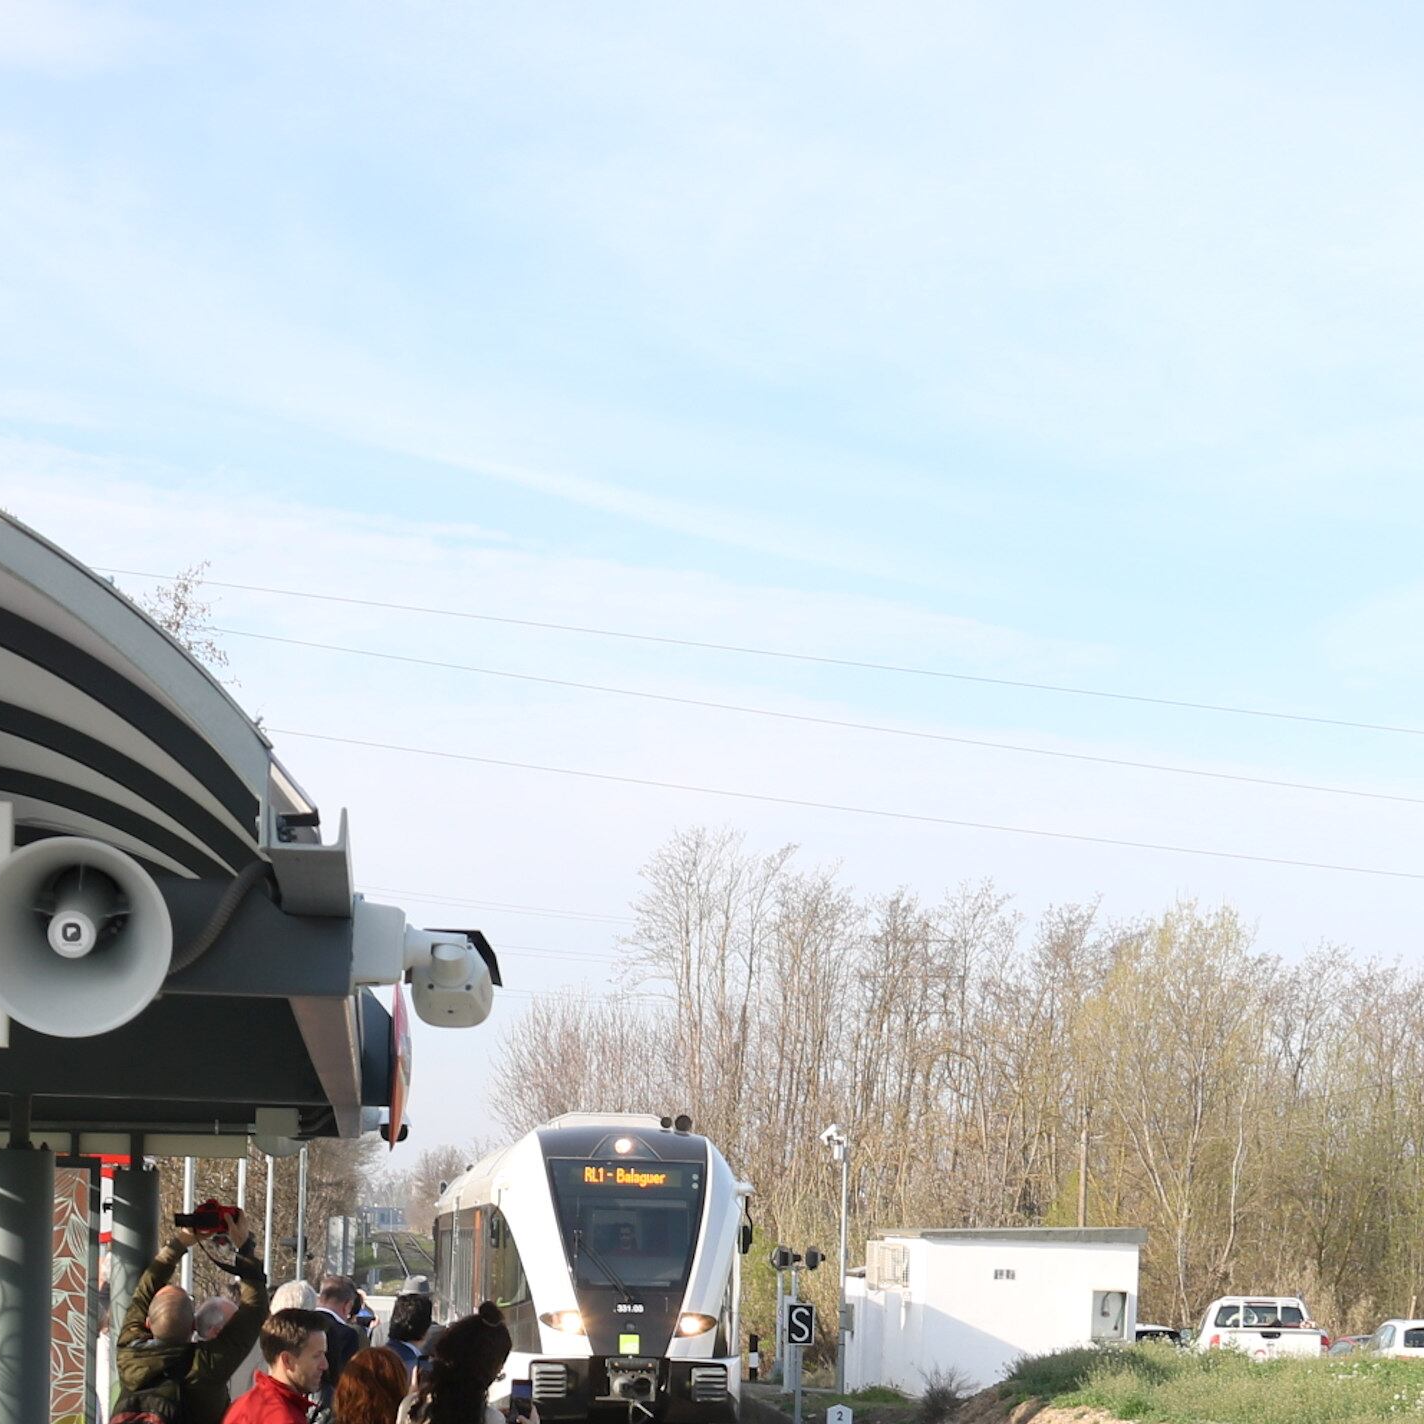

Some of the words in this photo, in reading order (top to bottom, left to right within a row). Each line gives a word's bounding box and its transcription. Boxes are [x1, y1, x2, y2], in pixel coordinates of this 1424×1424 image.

[584, 1166, 604, 1183] RL1
[616, 1167, 666, 1188] Balaguer
[791, 1307, 810, 1342] S
[836, 1411, 844, 1421] 2
